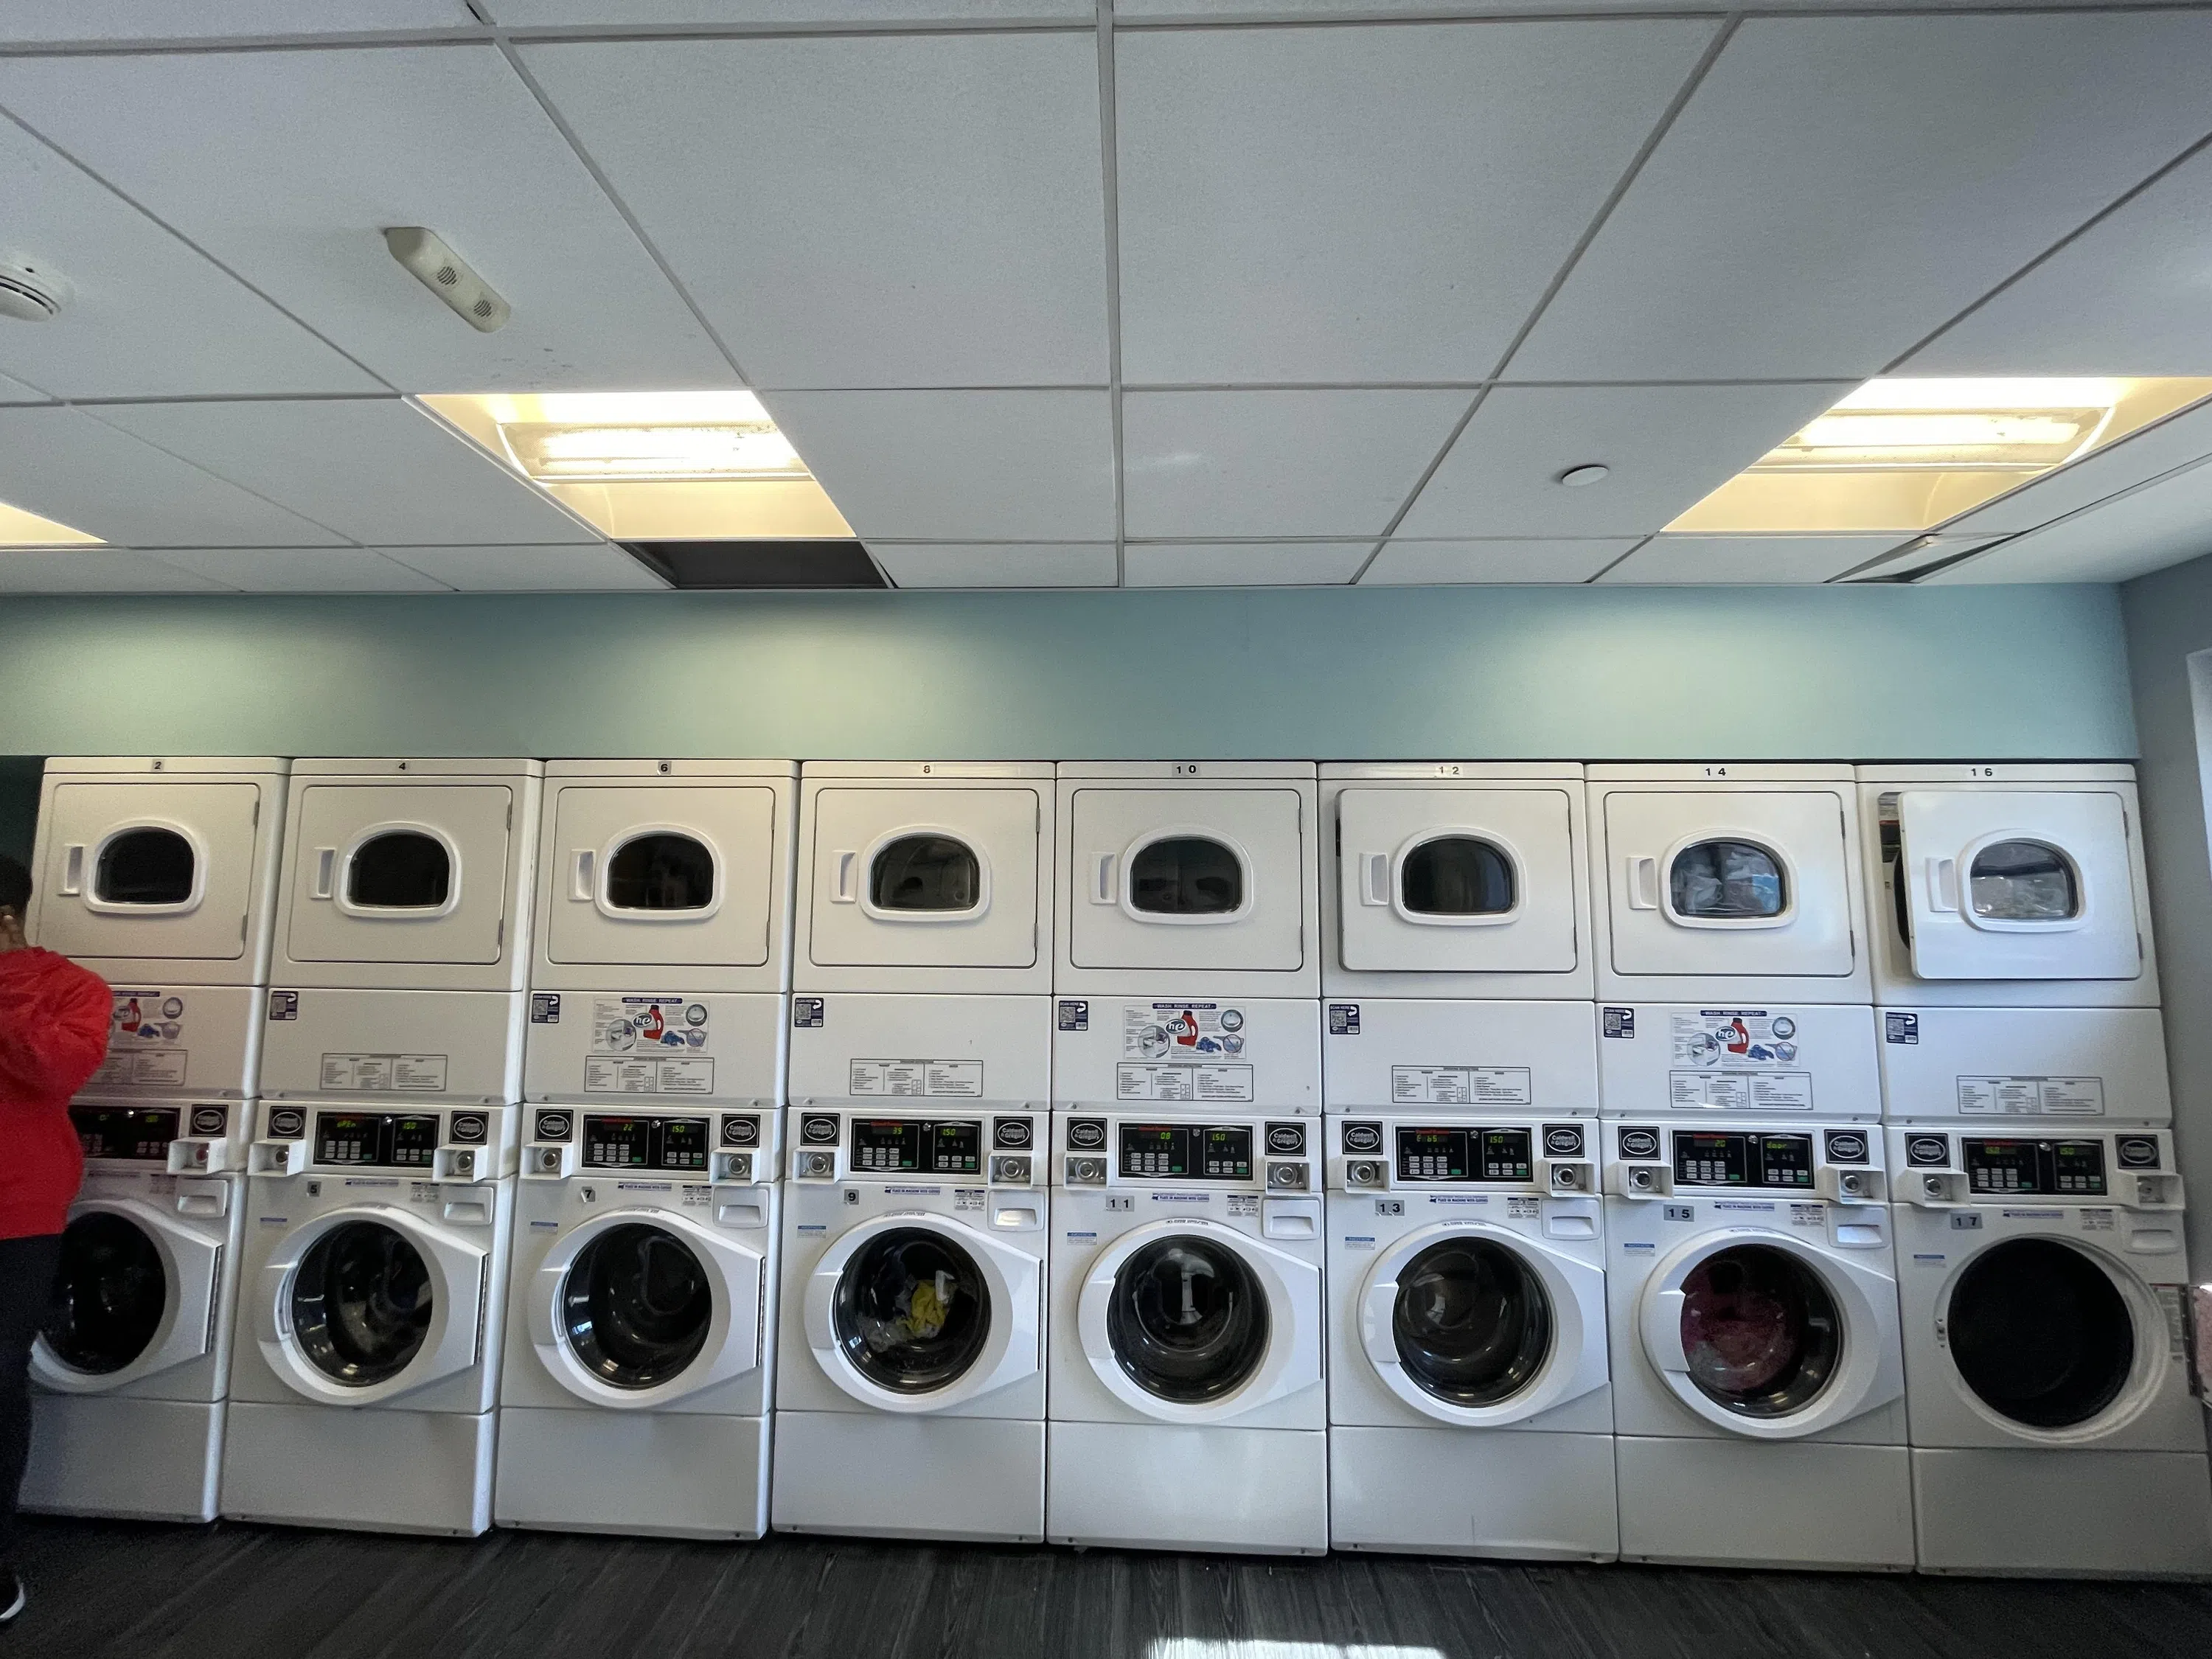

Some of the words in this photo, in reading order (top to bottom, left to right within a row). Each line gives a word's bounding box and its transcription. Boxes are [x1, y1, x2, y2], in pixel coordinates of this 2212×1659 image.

[154, 761, 161, 770] 2
[661, 764, 668, 772] 6
[923, 765, 931, 773] 8
[1176, 765, 1197, 774] 10
[1439, 765, 1459, 775] 12
[1705, 768, 1726, 776] 14
[1970, 768, 1992, 776] 16
[1160, 1132, 1171, 1140] 08
[310, 1184, 317, 1194] 5
[585, 1189, 592, 1199] 7
[848, 1192, 856, 1202] 9
[1110, 1198, 1129, 1208] 11
[1380, 1203, 1400, 1212] 13
[1668, 1208, 1690, 1218] 15
[1955, 1217, 1978, 1226] 17
